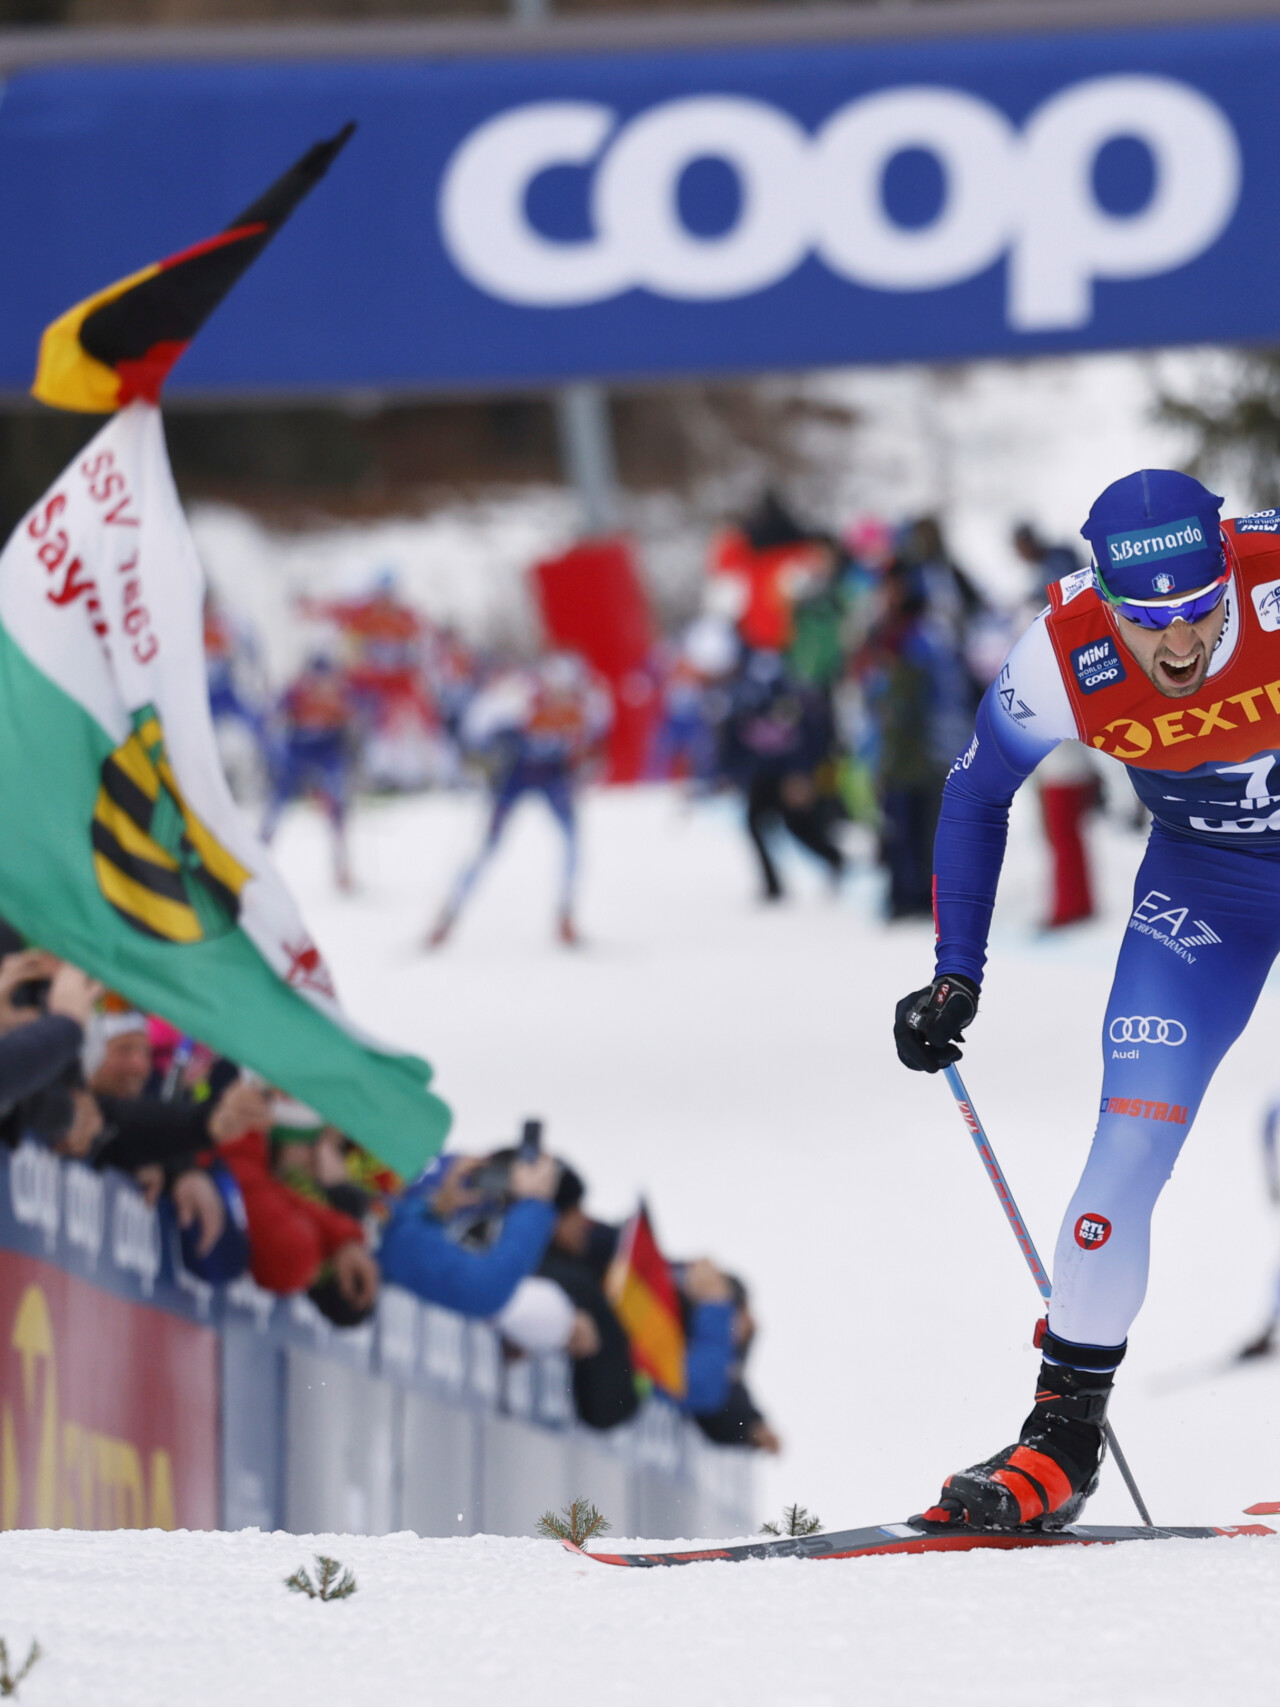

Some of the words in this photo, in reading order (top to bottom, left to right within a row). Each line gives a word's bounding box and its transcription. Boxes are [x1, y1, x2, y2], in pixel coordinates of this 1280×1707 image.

[436, 72, 1243, 332] coop
[82, 450, 140, 527] SSV
[1110, 526, 1202, 561] S.Bernardo
[1077, 664, 1103, 678] WORLD
[1103, 657, 1118, 667] CUP
[1085, 668, 1118, 687] coop
[1215, 754, 1277, 800] 7
[1133, 890, 1223, 947] EA7
[1111, 1049, 1140, 1060] Audi
[1106, 1096, 1189, 1125] FINSTRAL
[1078, 1229, 1104, 1242] 102.5
[1080, 1219, 1105, 1235] RTL
